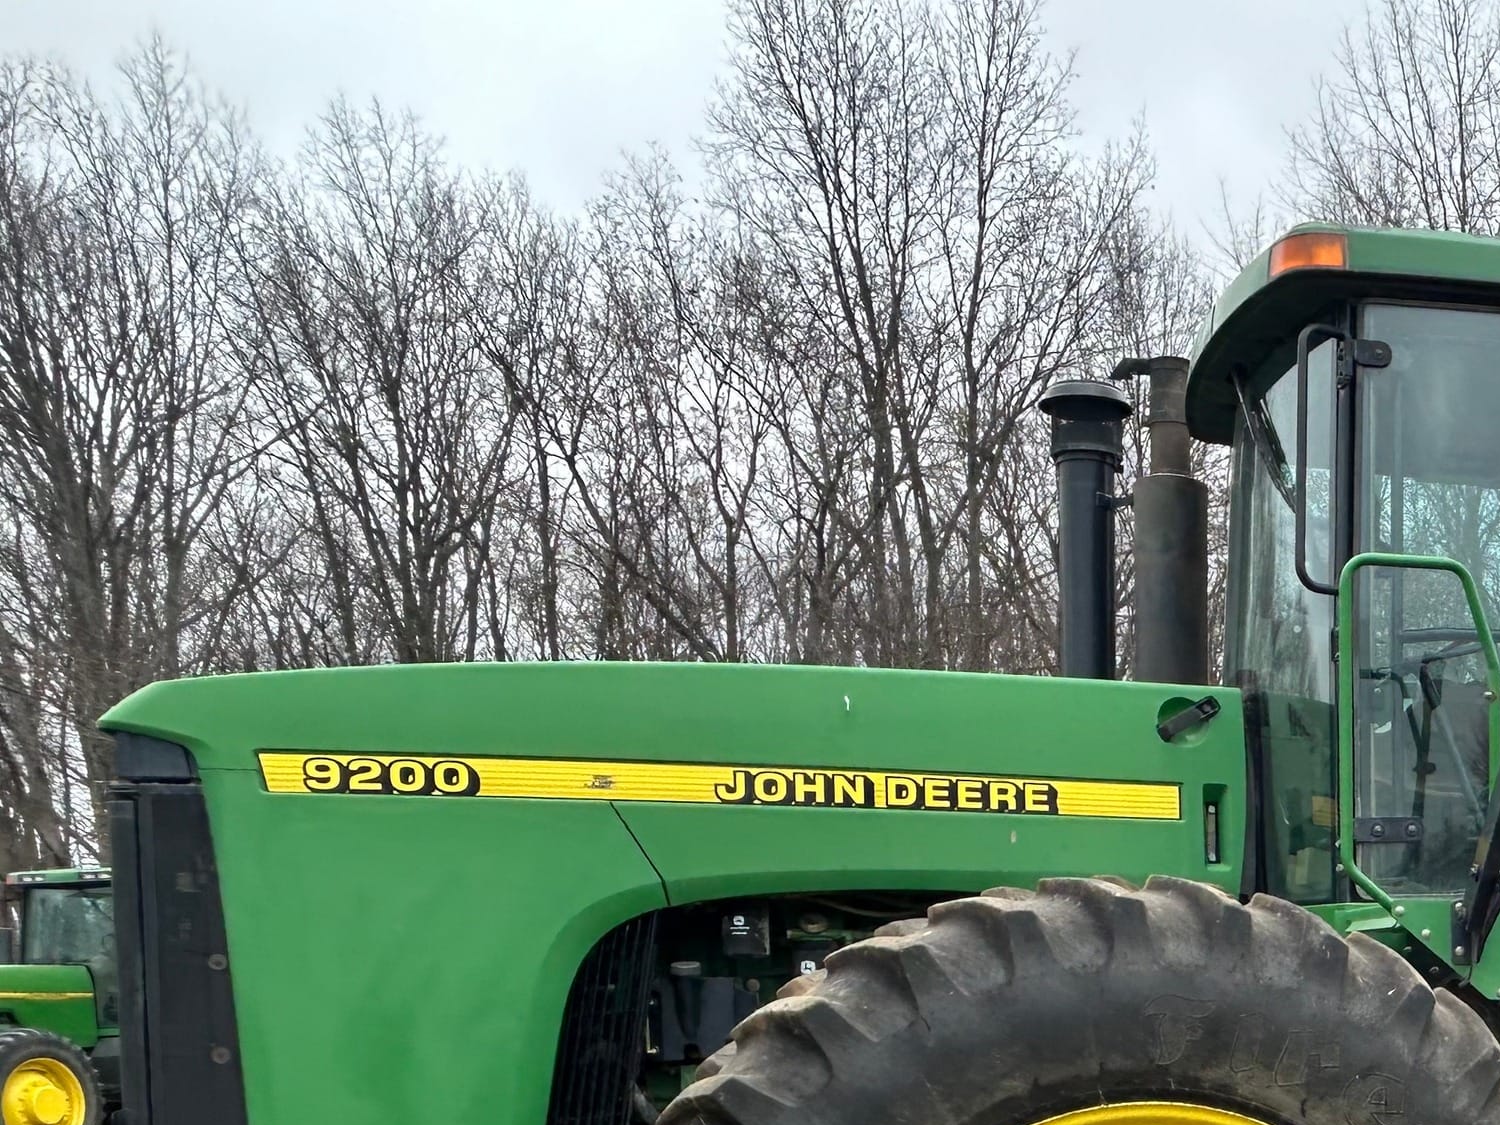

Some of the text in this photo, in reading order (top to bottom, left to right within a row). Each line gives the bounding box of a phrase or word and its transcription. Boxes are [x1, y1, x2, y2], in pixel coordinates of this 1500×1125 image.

[303, 757, 481, 796] 9200
[714, 770, 1059, 816] JOHN DEERE
